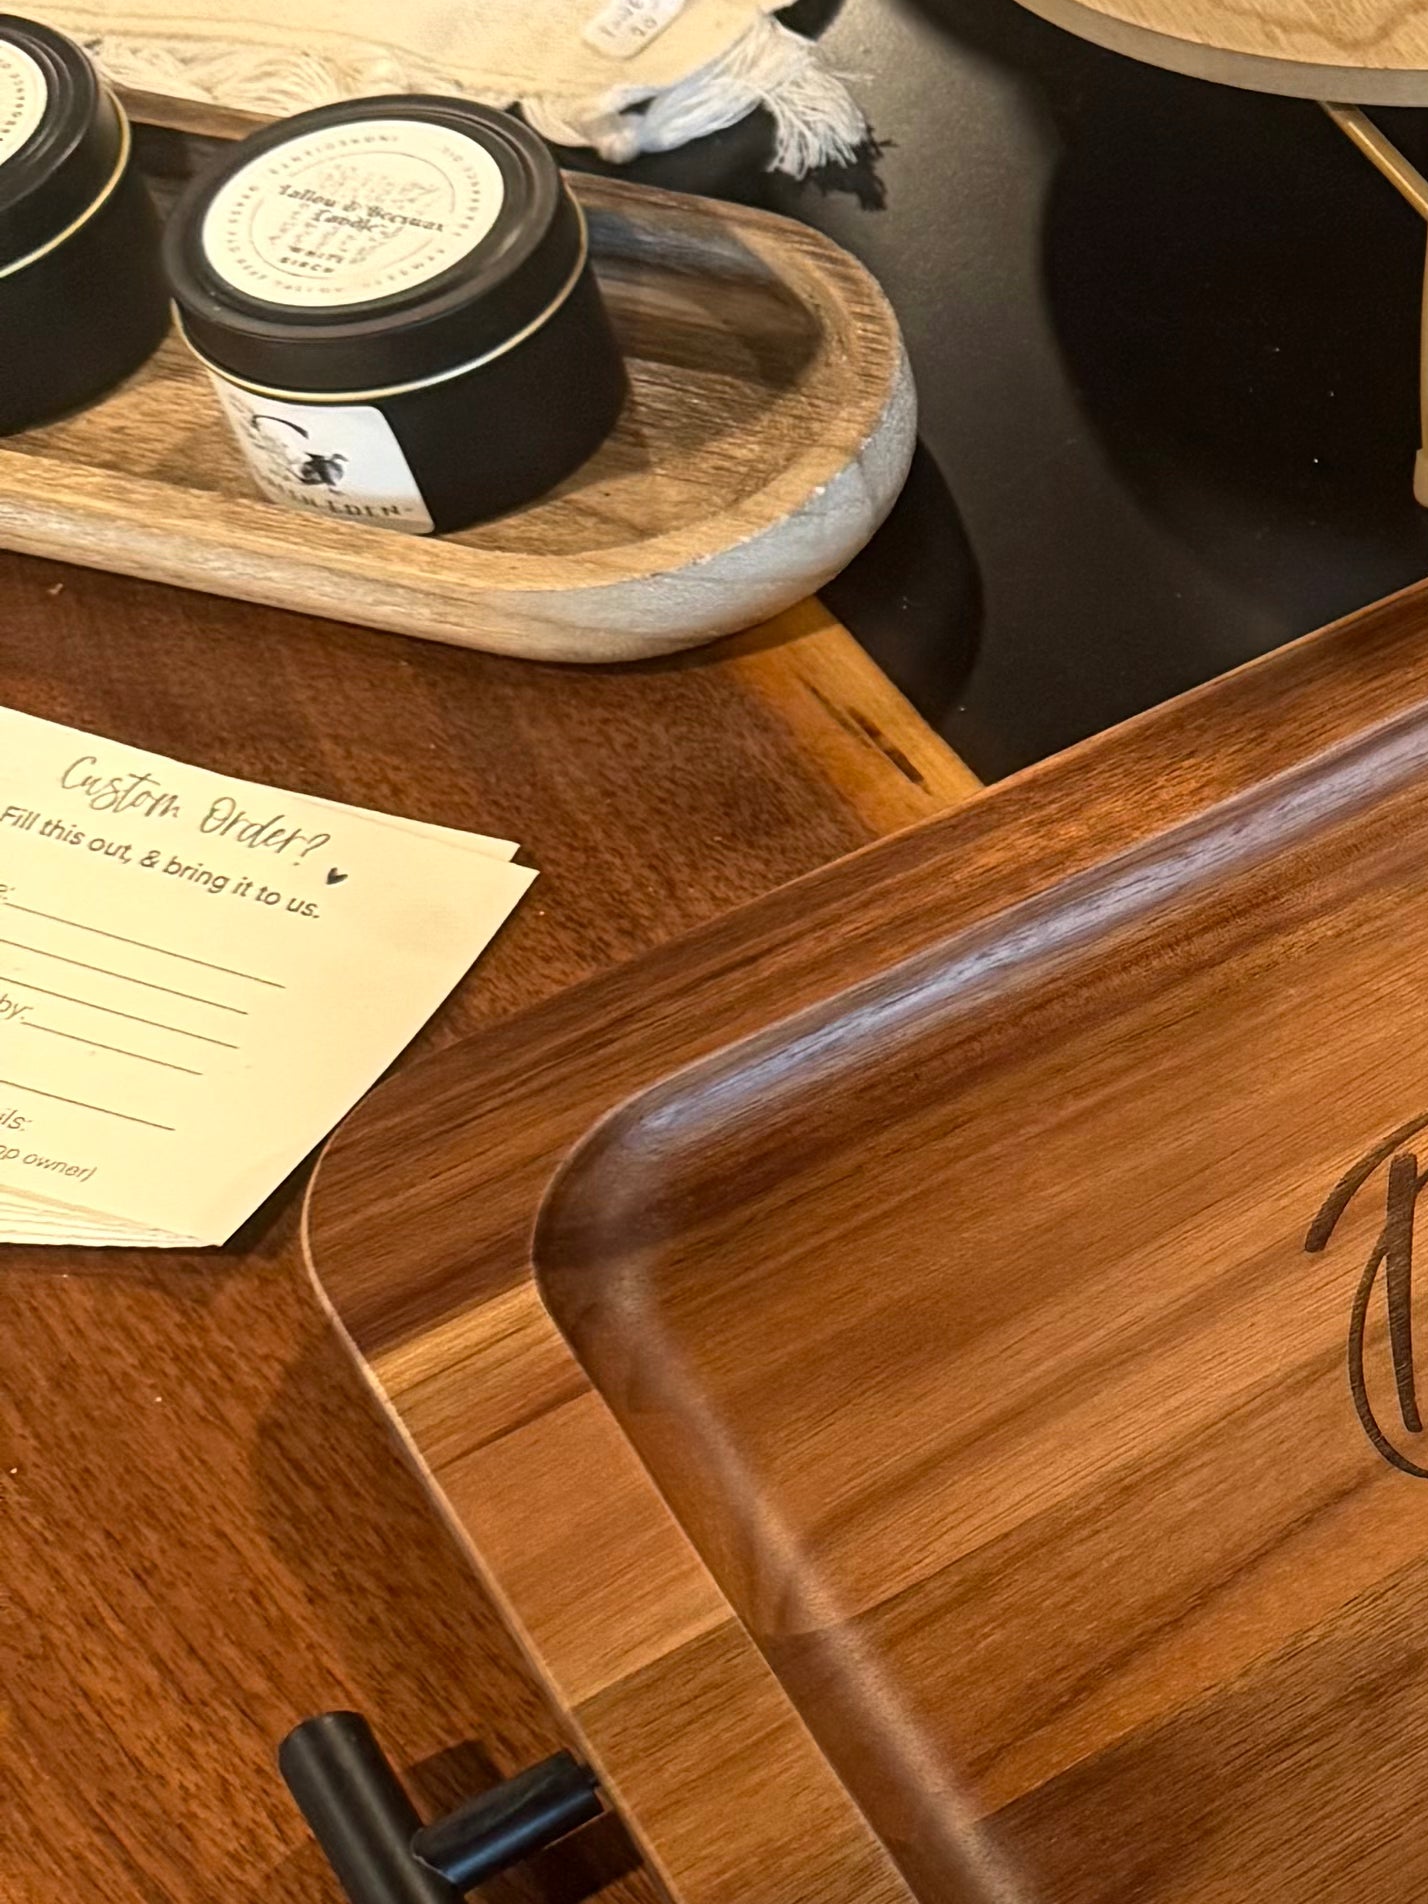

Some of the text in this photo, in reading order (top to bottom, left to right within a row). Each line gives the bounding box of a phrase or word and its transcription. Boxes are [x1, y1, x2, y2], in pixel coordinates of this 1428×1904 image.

[0, 805, 321, 919] Fill this out, & bring it to us.
[60, 755, 331, 867] Custom Order?
[22, 1152, 98, 1183] owner)
